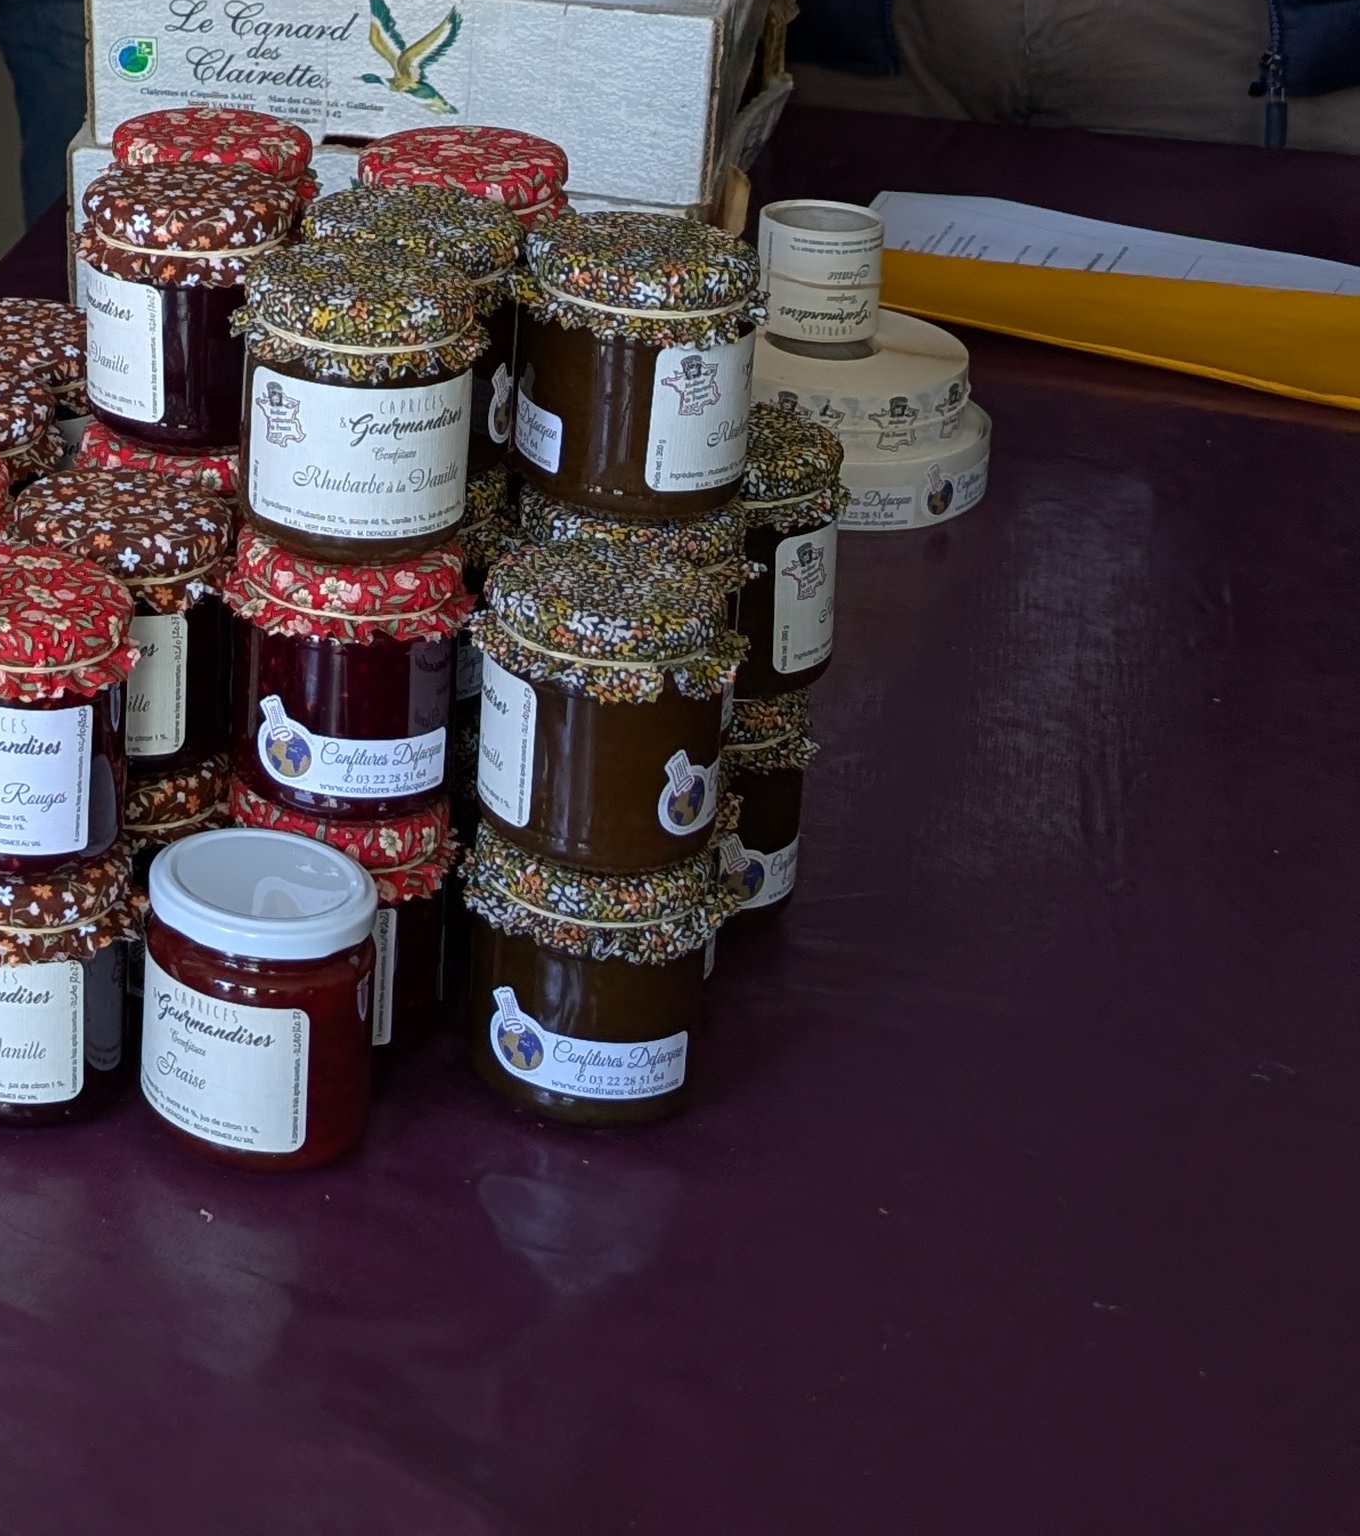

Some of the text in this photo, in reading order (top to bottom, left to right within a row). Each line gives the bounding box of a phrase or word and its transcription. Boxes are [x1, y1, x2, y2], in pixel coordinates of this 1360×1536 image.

[224, 0, 360, 41] Canard
[246, 38, 280, 61] des
[231, 92, 257, 102] SARL
[287, 95, 301, 105] des
[827, 263, 871, 286] Fraise
[777, 299, 869, 325] Gourmandises
[379, 394, 444, 415] CAPRICES
[339, 406, 464, 447] & Gourmandises
[372, 447, 417, 464] Confiture
[292, 461, 459, 494] Rhubarbe à la Vanille
[669, 470, 704, 481] Ingrédients
[863, 490, 913, 511] Defacque
[127, 694, 151, 713] ille
[320, 740, 443, 774] Confitures Defacque
[319, 775, 440, 794] www.confitures-defacque.com
[355, 768, 427, 785] 03 22 28 51 64
[0, 782, 68, 813] Rouges
[173, 987, 239, 1024] CAPRICES
[156, 992, 276, 1048] Gourmandises
[169, 1027, 207, 1057] Confiture
[552, 1039, 684, 1074] Confitures Defacque
[156, 1050, 207, 1090] Fraise
[588, 1071, 665, 1087] 03 22 28 51 64
[8, 1082, 19, 1091] jus
[20, 1081, 29, 1090] de
[30, 1081, 50, 1090] citron
[551, 1078, 679, 1096] www.confitures-defacque.com
[210, 1117, 221, 1125] de
[222, 1121, 243, 1131] citron
